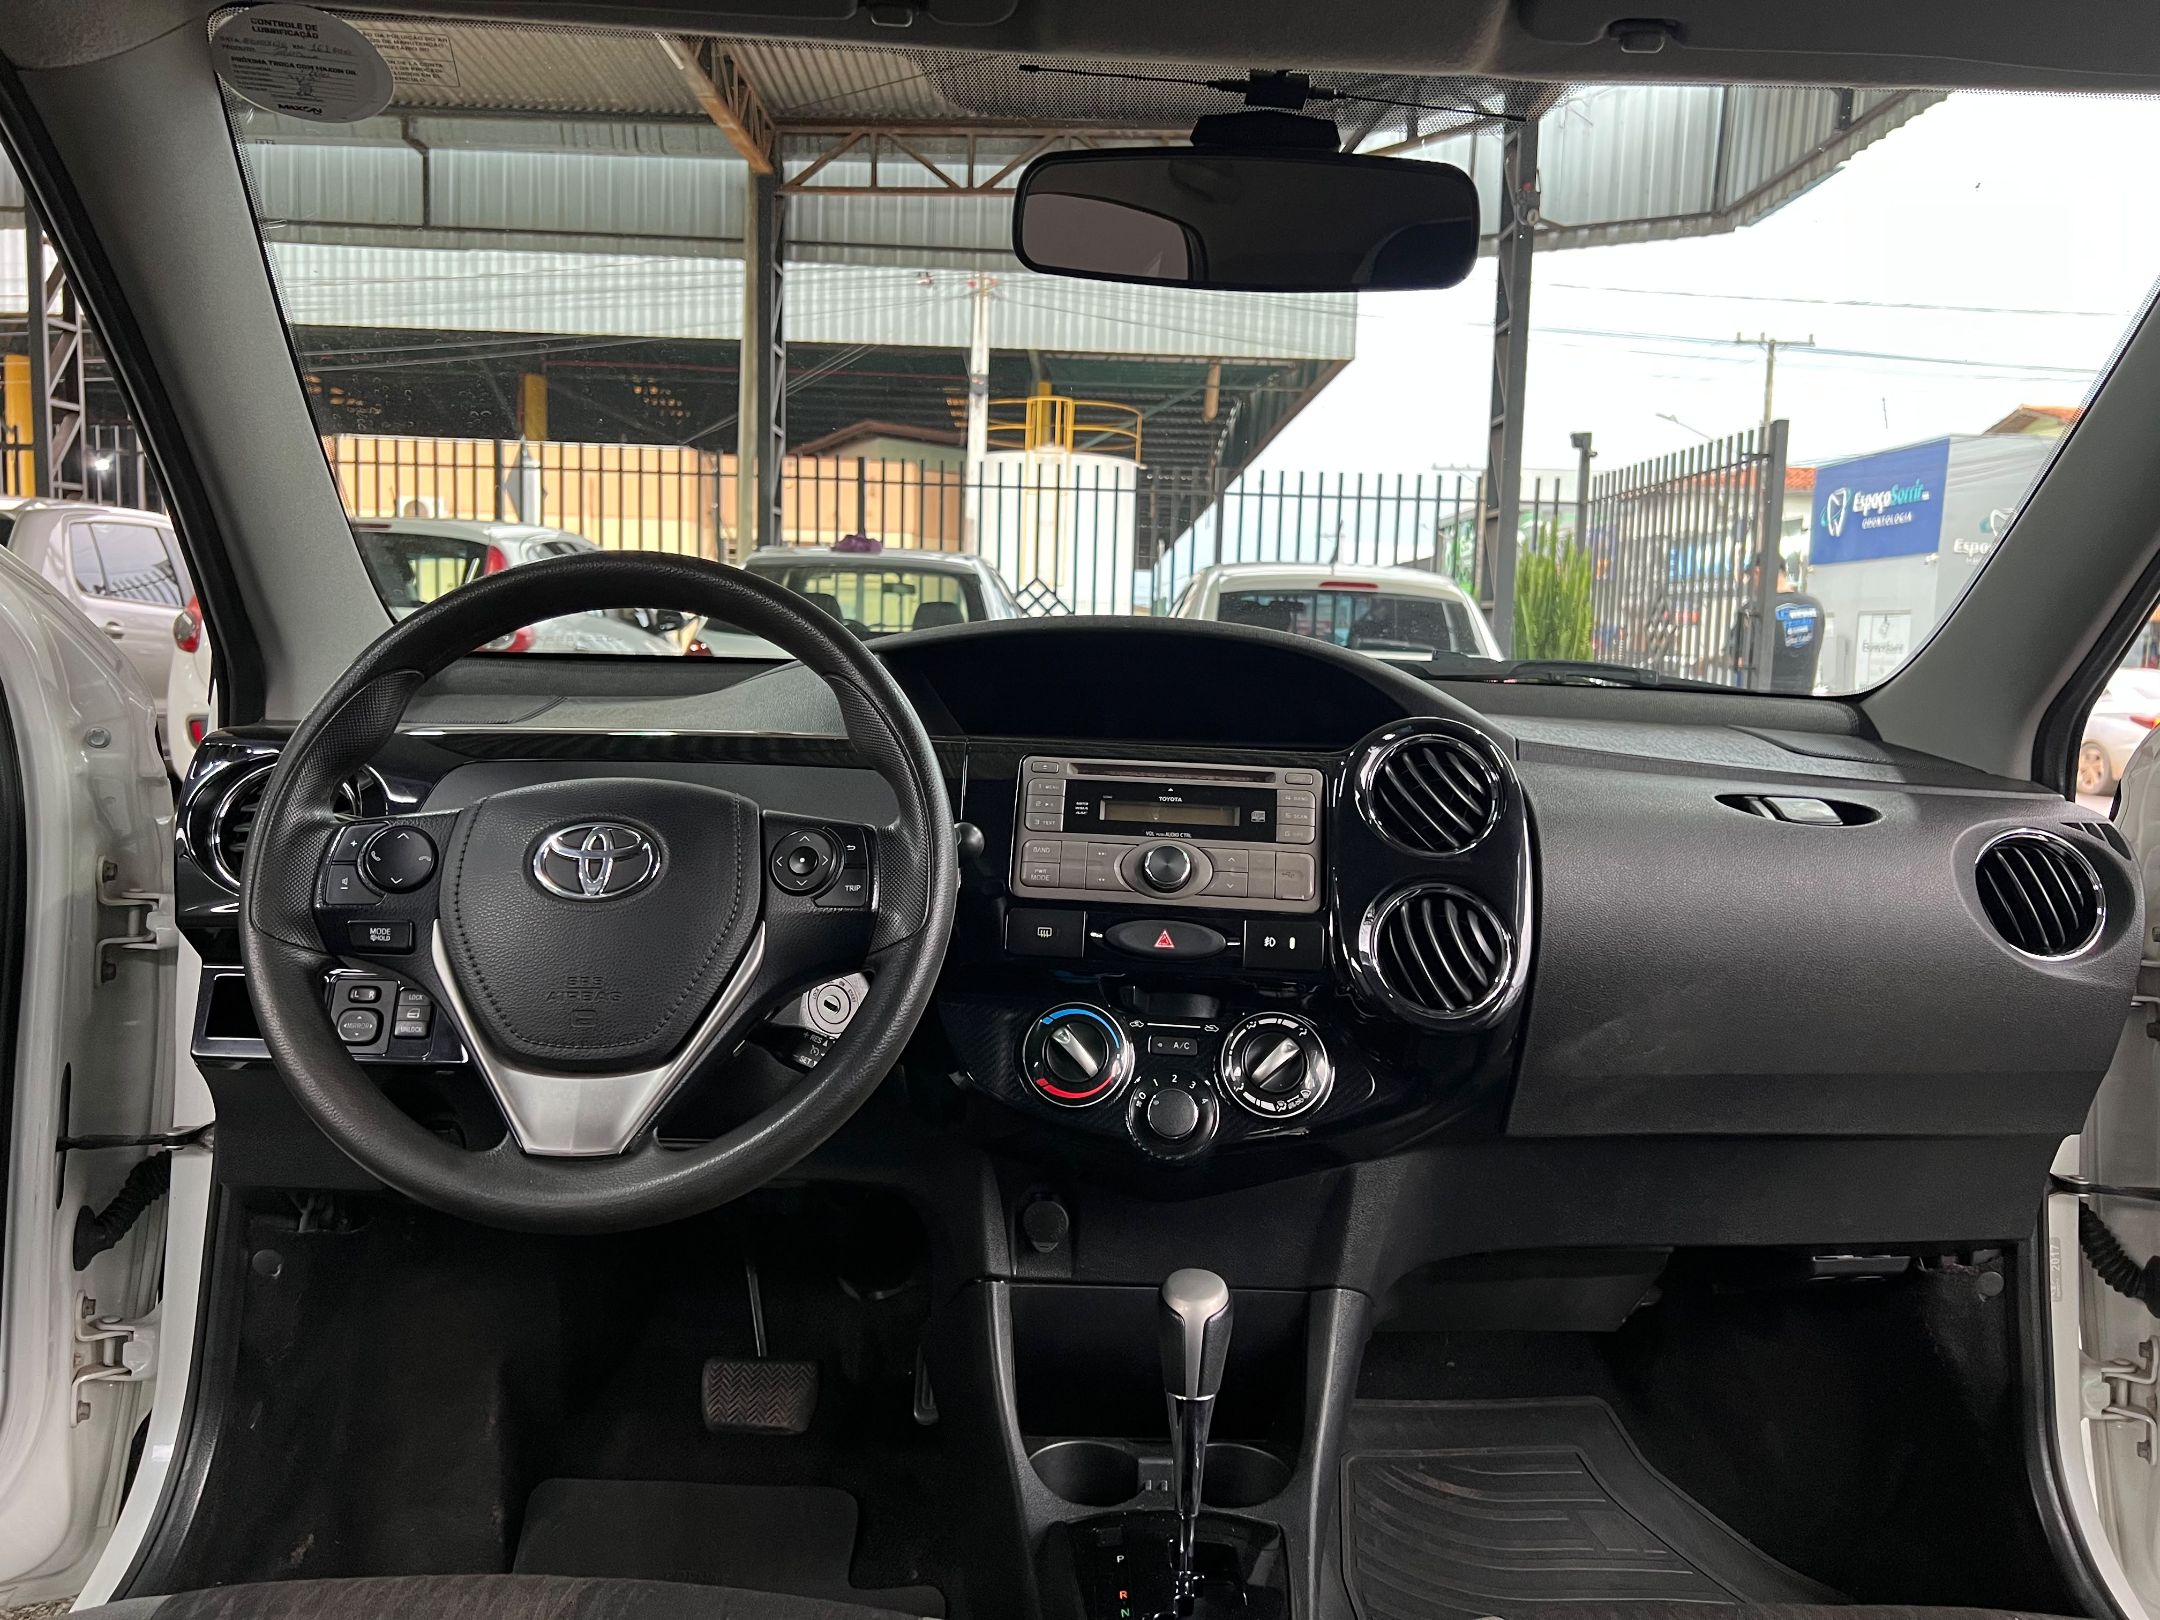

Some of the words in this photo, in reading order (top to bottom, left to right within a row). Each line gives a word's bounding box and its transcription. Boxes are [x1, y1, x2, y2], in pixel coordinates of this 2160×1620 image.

[250, 17, 303, 30] CONTROLE
[305, 23, 319, 32] DE
[252, 26, 319, 40] LUBRIFICAÇÃO
[1862, 512, 1913, 530] ODONTOLOGIA
[845, 884, 861, 892] TRIP
[369, 927, 391, 935] MODE
[368, 990, 375, 999] R
[810, 1035, 823, 1044] RES
[1173, 1041, 1190, 1050] A/C
[799, 1055, 812, 1065] SET
[1171, 1074, 1178, 1083] 2
[1188, 1080, 1196, 1089] 3
[2050, 1244, 2060, 1271] 2017
[1116, 1555, 1125, 1563] P
[1119, 1590, 1128, 1599] R
[1120, 1608, 1130, 1618] N
